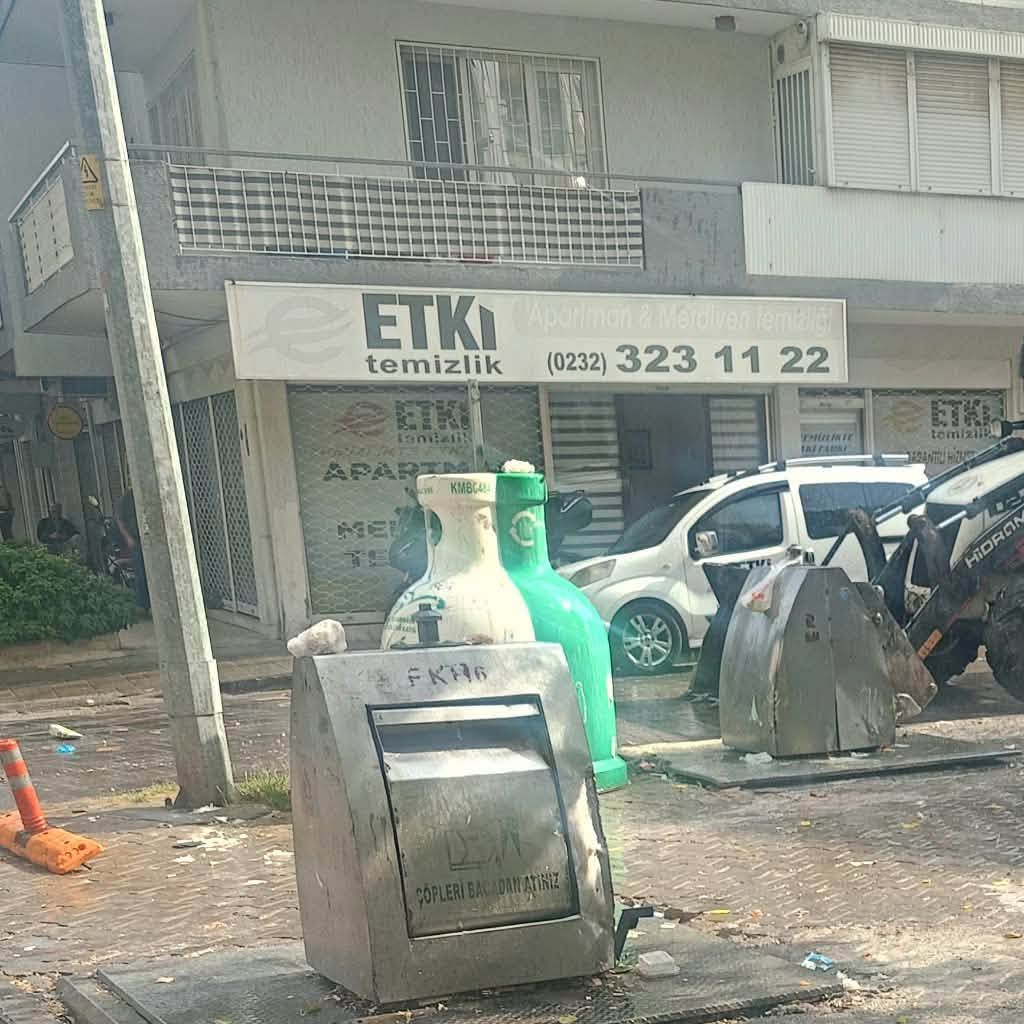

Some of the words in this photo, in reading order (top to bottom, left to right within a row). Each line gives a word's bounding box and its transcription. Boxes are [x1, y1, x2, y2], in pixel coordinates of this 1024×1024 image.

[366, 354, 503, 375] temizlik
[547, 351, 607, 377] (0232)
[616, 344, 697, 373] 323
[714, 345, 760, 373] 11
[780, 346, 830, 373] 22
